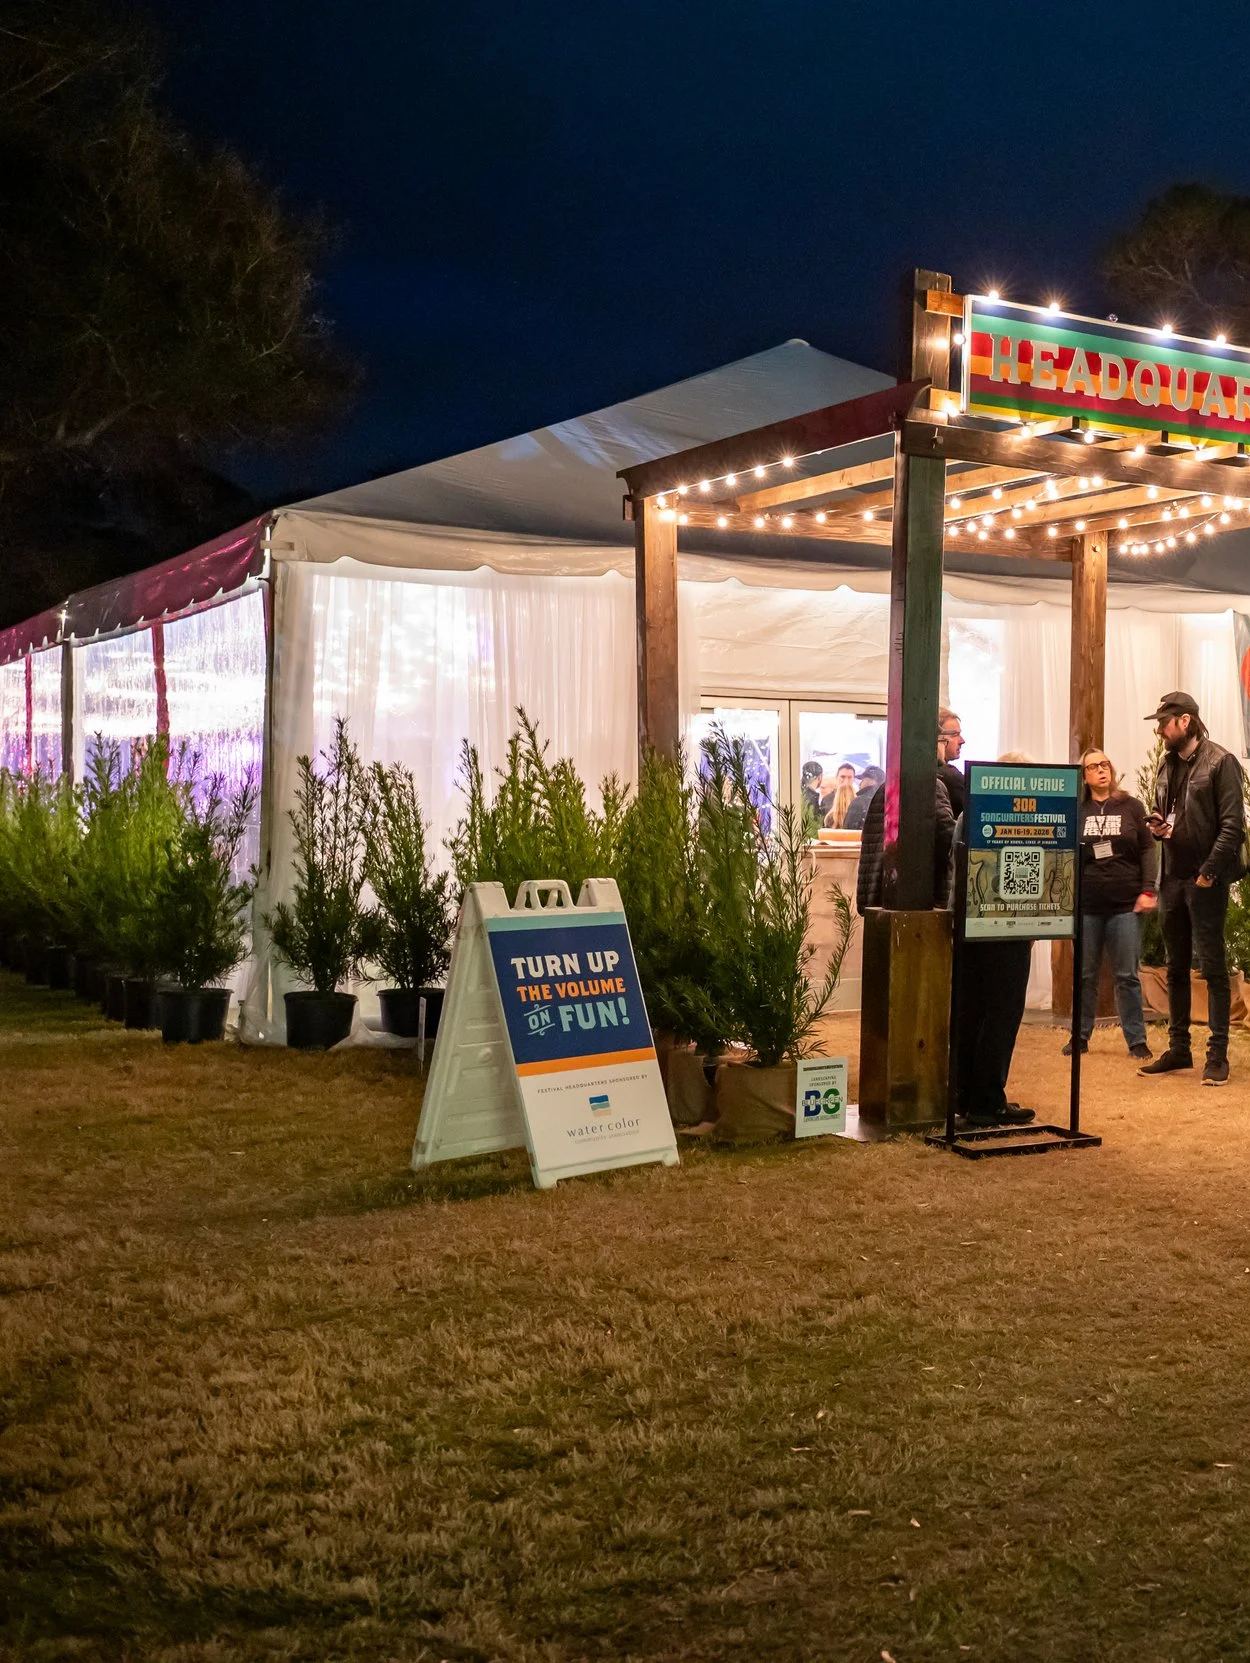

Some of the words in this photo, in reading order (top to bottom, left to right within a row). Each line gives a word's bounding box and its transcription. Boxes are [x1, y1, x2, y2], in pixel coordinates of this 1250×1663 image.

[981, 775, 1026, 790] OFFICIAL
[1030, 777, 1065, 791] VENUE
[1012, 797, 1036, 812] 30A
[980, 903, 996, 911] SCAN
[997, 903, 1005, 911] TO
[1006, 903, 1037, 911] PURCHASE
[1039, 902, 1061, 911] TICKETS
[510, 953, 581, 979] TURN
[586, 950, 620, 973] UP
[516, 984, 553, 1002] THE
[554, 977, 626, 999] VOLUME
[528, 1009, 551, 1030] ON
[558, 997, 630, 1032] FUN!
[537, 1086, 564, 1094] FESTIVAL
[564, 1079, 608, 1090] HEADQUARTERS
[608, 1075, 640, 1084] SPONSORED
